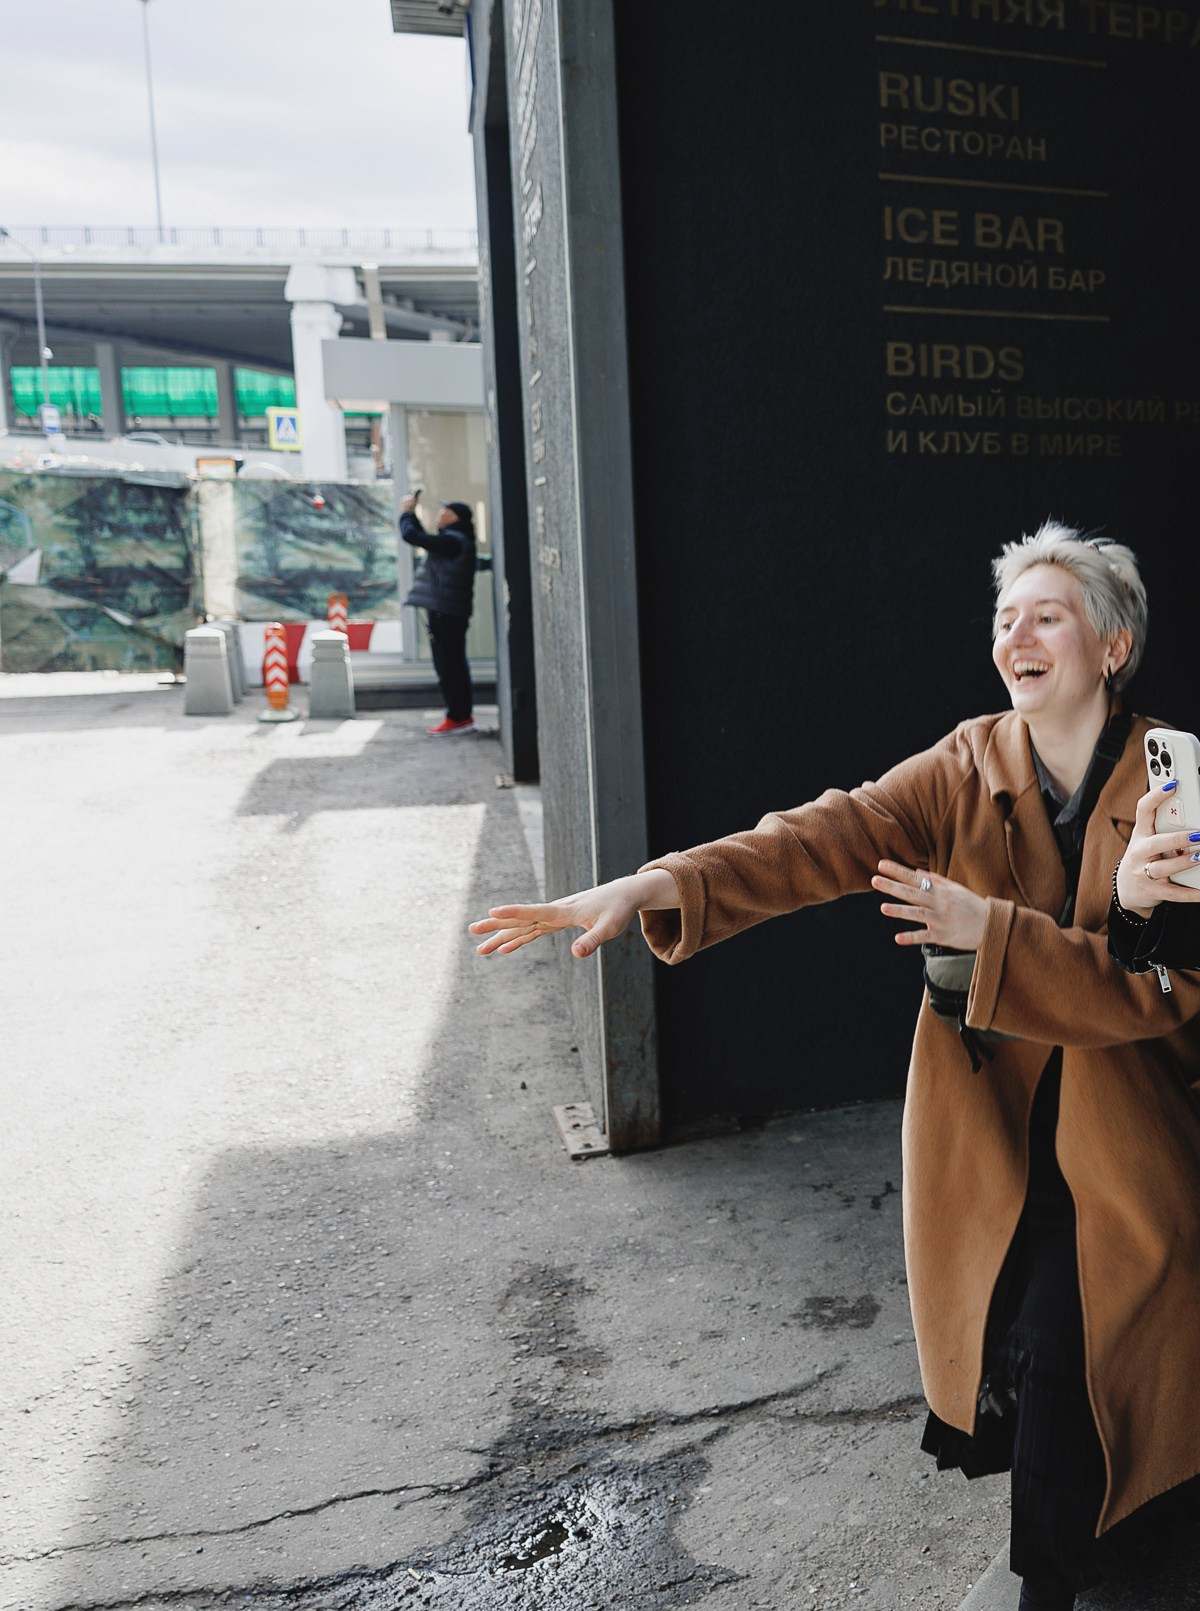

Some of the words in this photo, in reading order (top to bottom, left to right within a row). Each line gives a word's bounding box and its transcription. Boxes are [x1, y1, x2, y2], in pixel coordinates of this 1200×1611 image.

[878, 71, 1020, 121] RUSKI
[879, 122, 1047, 161] РЕСТОРАН
[883, 205, 960, 246] ICE
[974, 211, 1065, 253] BAR
[882, 255, 1038, 289] ЛЕДЯНОЙ
[1047, 267, 1106, 293] БАР
[885, 340, 1025, 382] BIRDS
[885, 388, 1006, 418] САМЫЙ
[1015, 394, 1166, 422] ВЫСОКИЙ
[886, 430, 908, 454] И
[918, 430, 1001, 455] КЛУБ
[1010, 432, 1030, 455] В
[1039, 433, 1122, 458] МИРЕ
